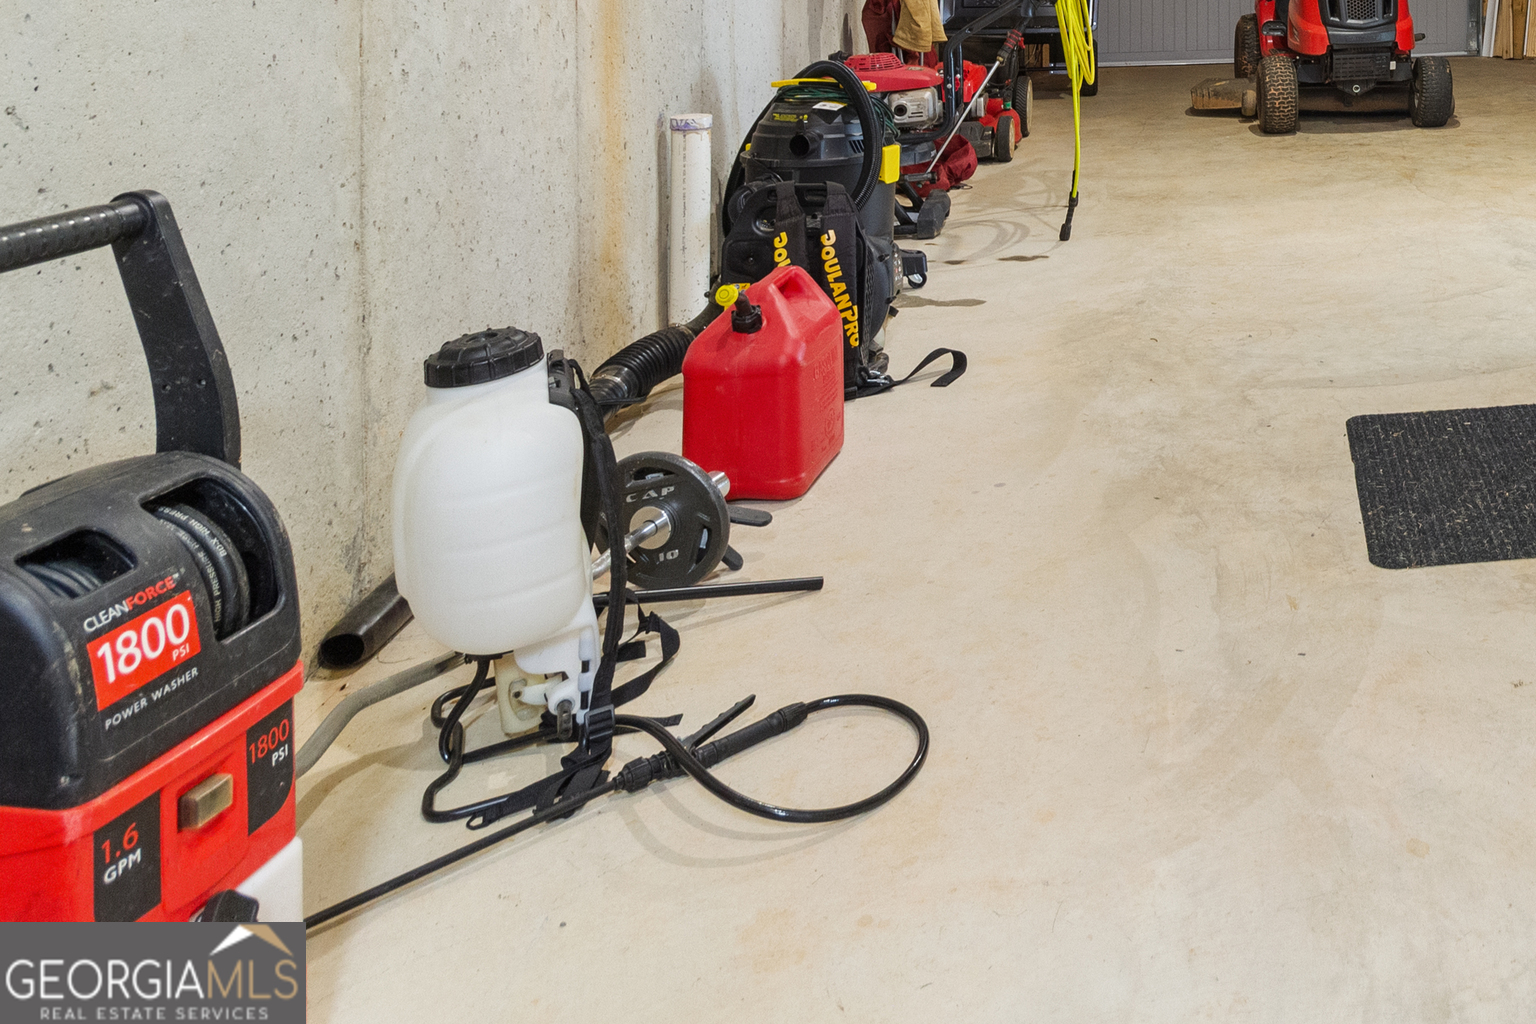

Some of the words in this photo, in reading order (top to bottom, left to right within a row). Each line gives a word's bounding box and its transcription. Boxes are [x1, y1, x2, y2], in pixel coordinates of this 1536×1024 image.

[626, 485, 675, 503] CAP
[188, 518, 211, 536] HIGH
[198, 551, 221, 597] PRESSURE
[83, 575, 177, 633] CLEANFORCE
[97, 603, 190, 684] 1800
[172, 642, 190, 662] PSI
[104, 697, 148, 731] POWER
[151, 666, 199, 701] WASHER
[249, 718, 290, 765] 1800
[271, 743, 289, 767] PSI
[101, 822, 139, 864] 1.6
[103, 848, 142, 884] GPM
